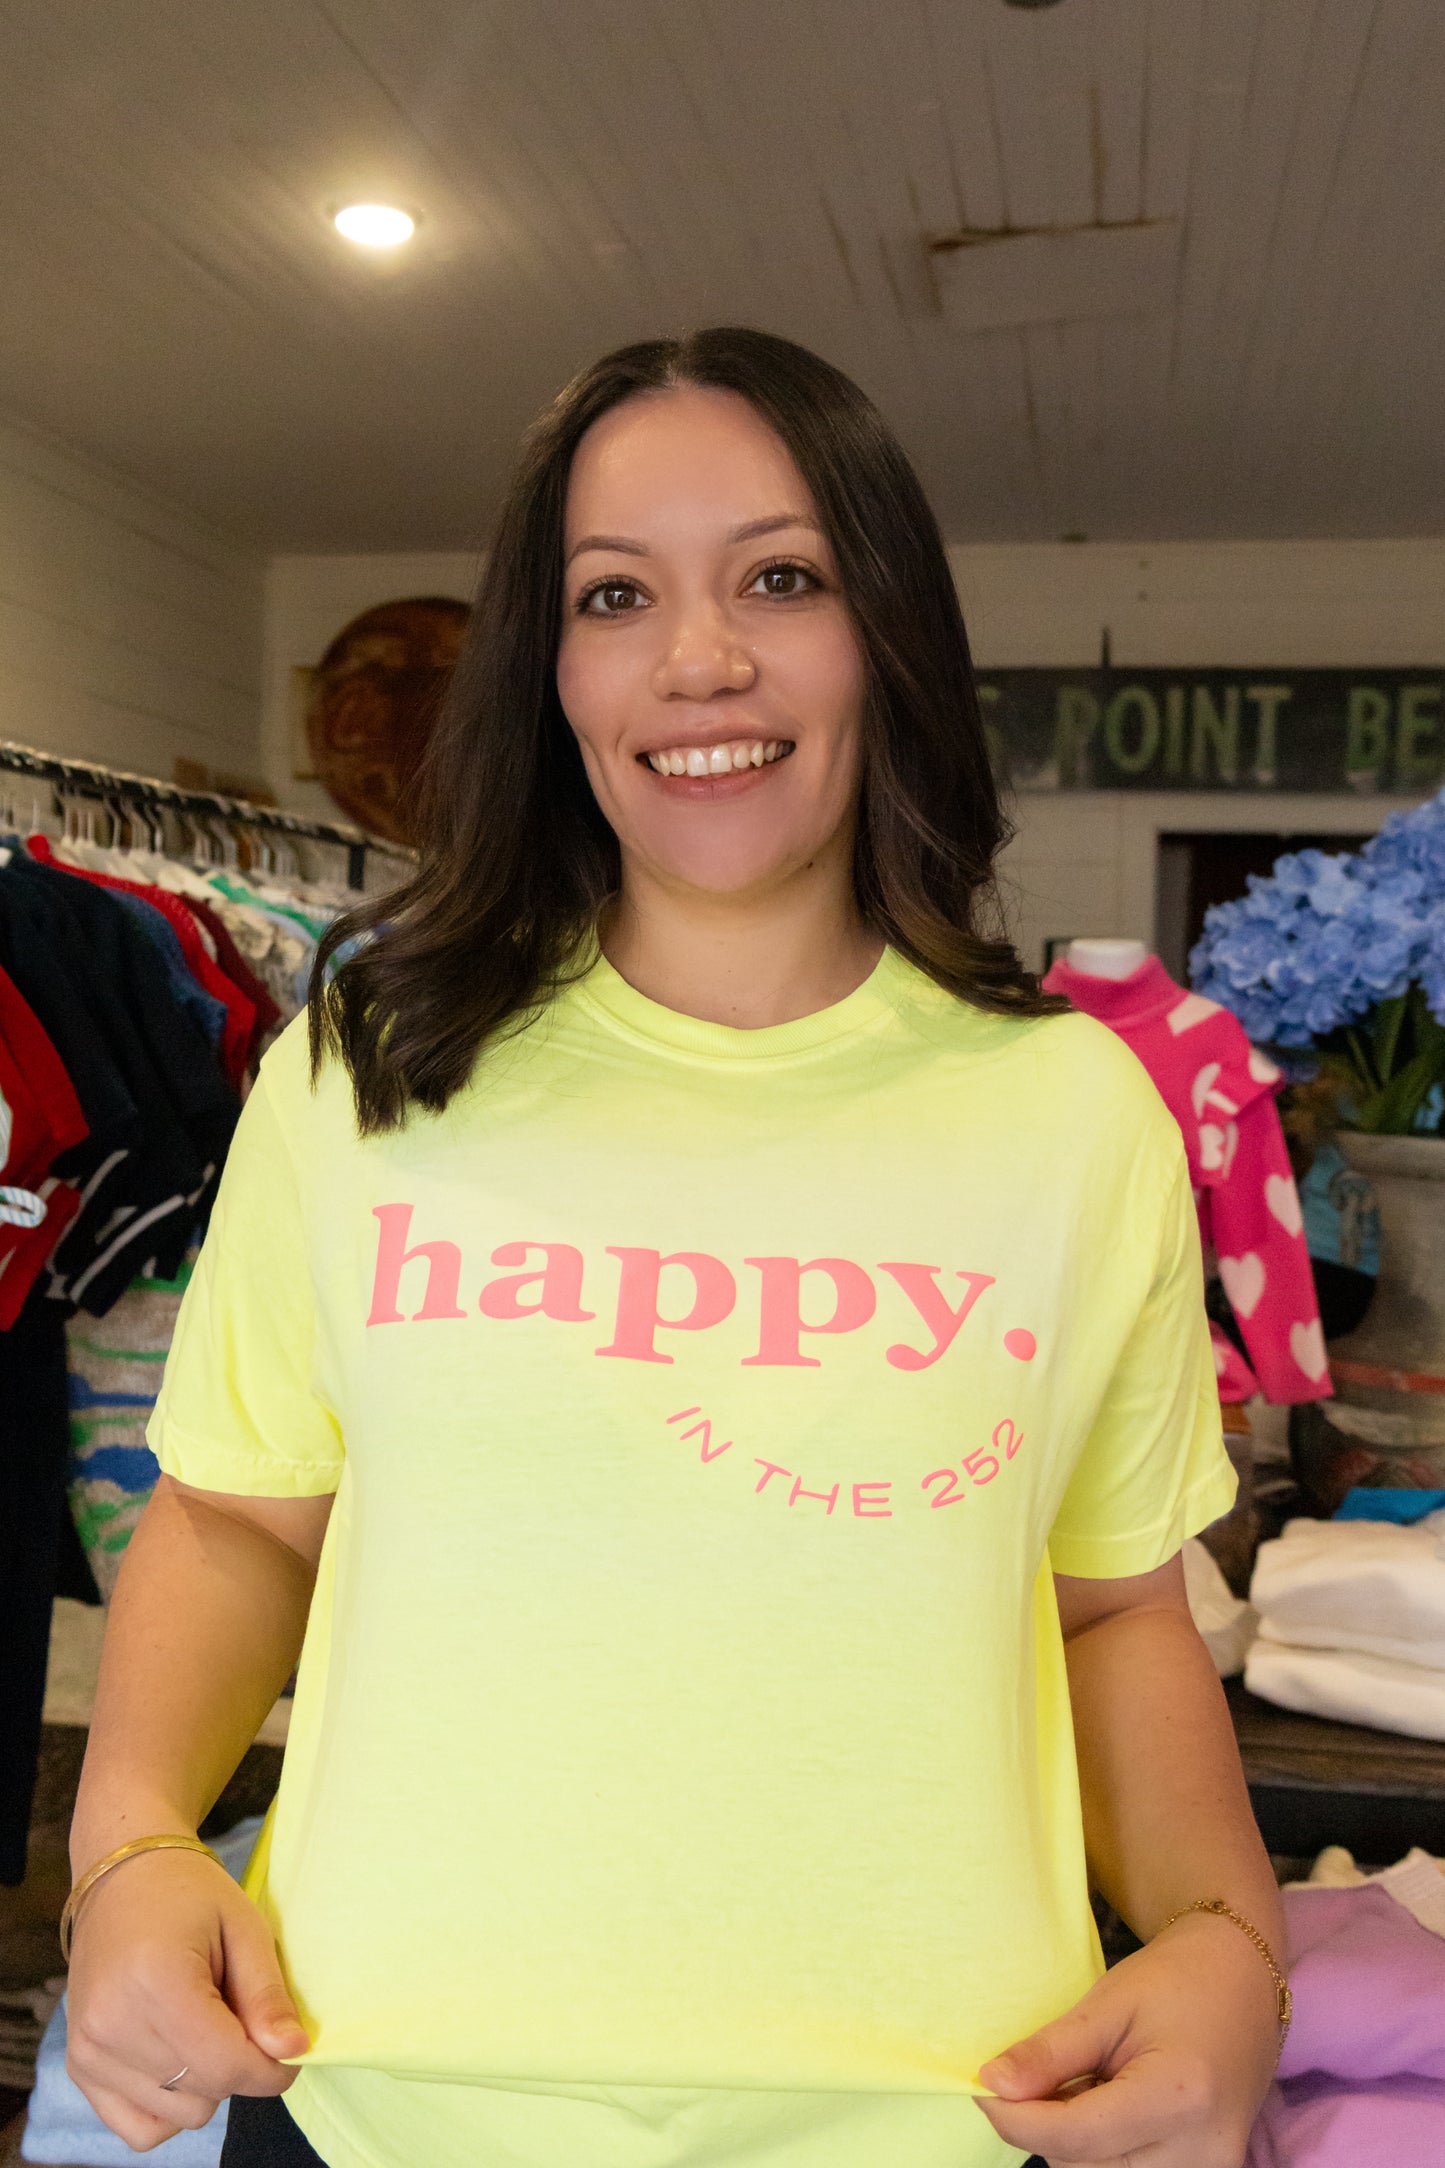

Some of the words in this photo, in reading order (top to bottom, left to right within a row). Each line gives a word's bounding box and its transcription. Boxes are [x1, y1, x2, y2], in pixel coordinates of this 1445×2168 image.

[1052, 684, 1295, 784] POINT
[366, 1203, 1037, 1372] happy.
[666, 1406, 733, 1463] IN
[754, 1458, 893, 1518] THE
[920, 1418, 1025, 1509] 252
